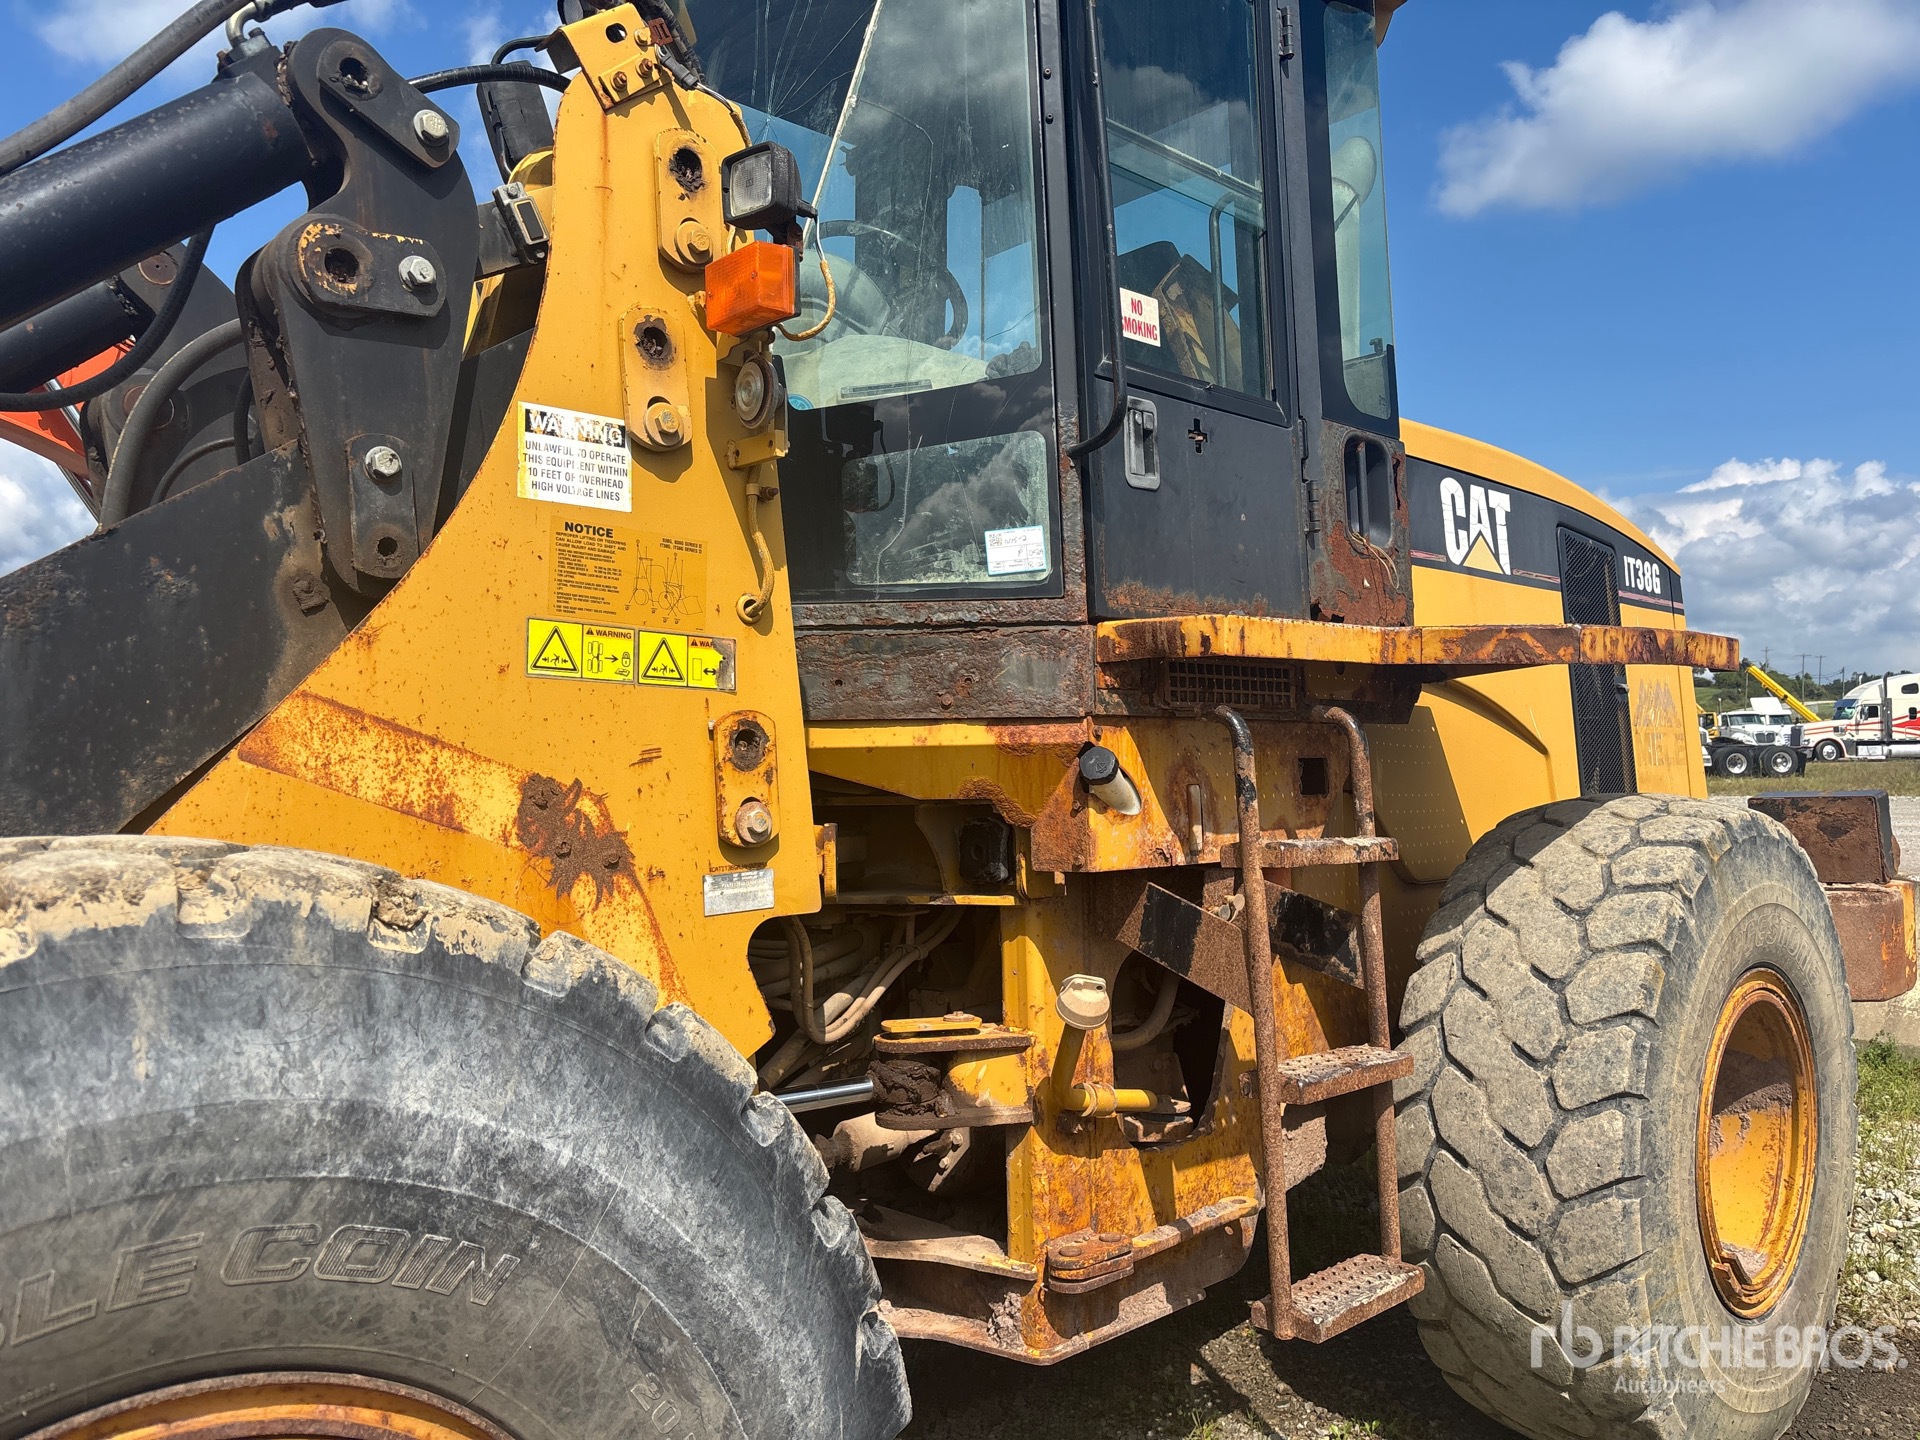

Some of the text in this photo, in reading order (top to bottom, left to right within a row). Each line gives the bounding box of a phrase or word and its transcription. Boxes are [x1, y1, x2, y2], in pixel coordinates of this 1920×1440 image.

[1131, 298, 1143, 316] NO
[1122, 316, 1158, 341] MOKING
[528, 408, 623, 446] WANING
[525, 440, 574, 457] UNLAWFUL
[589, 450, 626, 465] OPERATE
[523, 453, 543, 465] THIS
[597, 463, 628, 478] WITHIN
[528, 467, 538, 477] 10
[541, 468, 562, 480] FEET
[579, 474, 624, 490] OVERHEAD
[531, 480, 554, 492] HIGH
[596, 490, 621, 502] LINES
[564, 521, 614, 538] NOTICE
[1440, 477, 1511, 575] CAT
[1623, 555, 1661, 595] IT38G
[595, 629, 633, 640] WARNING
[0, 1222, 521, 1348] LE COIN
